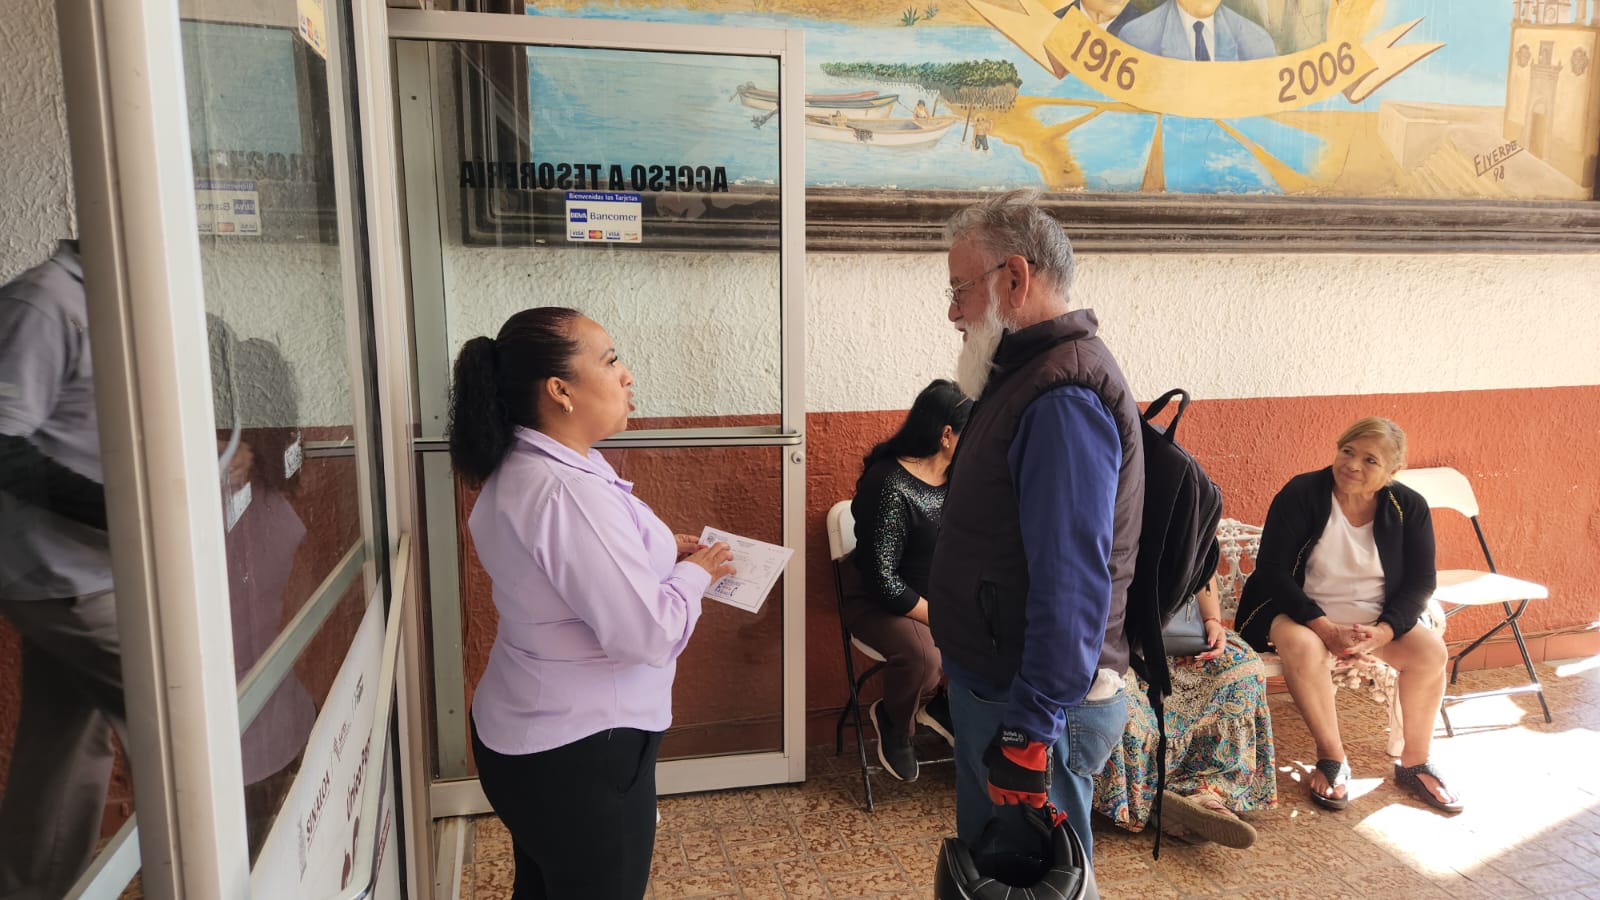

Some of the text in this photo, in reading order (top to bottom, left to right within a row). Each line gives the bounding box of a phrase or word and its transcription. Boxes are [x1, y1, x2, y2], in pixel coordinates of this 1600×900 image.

[1070, 29, 1139, 91] 1916
[1278, 41, 1356, 103] 2006
[568, 192, 603, 201] Bienvenidas
[615, 194, 638, 203] Tarjetas
[590, 211, 638, 221] Bancomer
[306, 770, 330, 843] SINALOA
